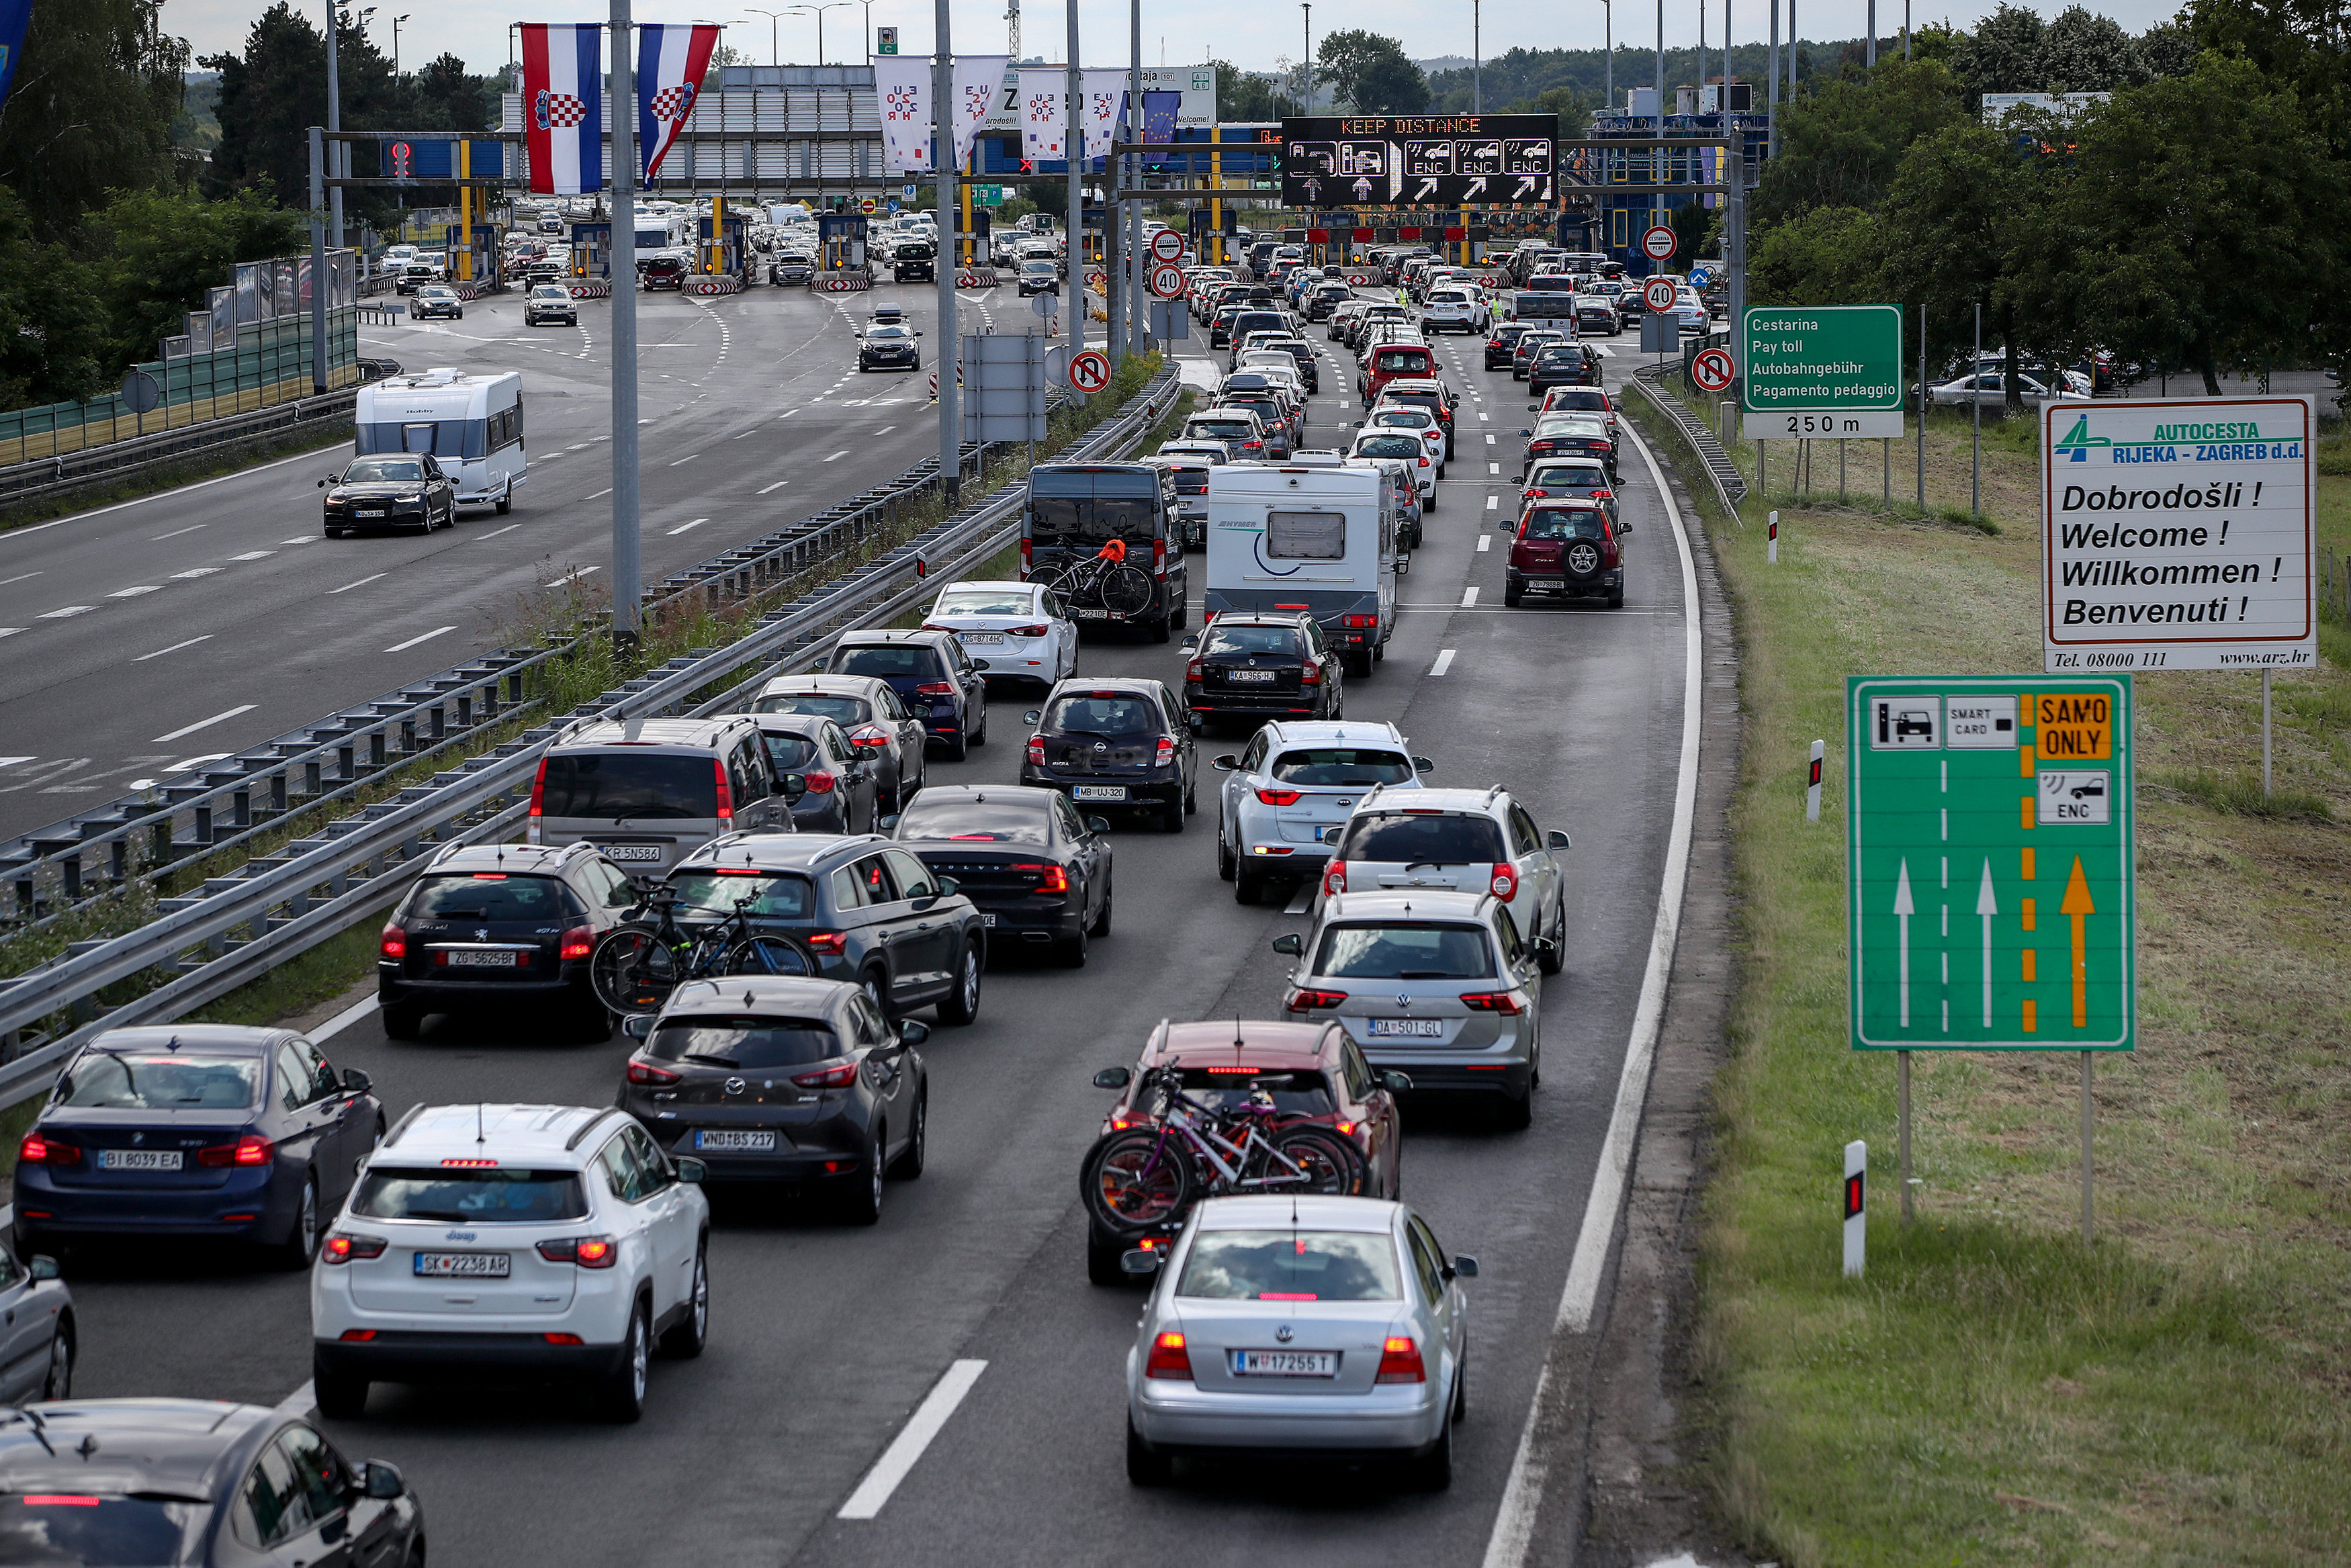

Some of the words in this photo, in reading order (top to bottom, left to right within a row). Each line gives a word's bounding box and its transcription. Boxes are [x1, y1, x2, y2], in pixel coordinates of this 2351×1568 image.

[1341, 119, 1387, 134] KEEP
[1395, 118, 1481, 134] DISTANCE
[1414, 163, 1444, 173] ENC
[1463, 163, 1493, 173] ENC
[1512, 161, 1542, 173] ENC
[1159, 273, 1177, 289] 40
[1650, 287, 1670, 303] 40
[1753, 318, 1818, 331] Cestarina
[1753, 340, 1777, 355] Pay
[1781, 340, 1803, 353] toll
[1752, 361, 1864, 377] Autobahngebühr
[1753, 384, 1830, 400] Pagamento
[1834, 383, 1896, 399] pedaggio
[1787, 416, 1833, 432] 250
[1843, 418, 1860, 432] m
[2154, 422, 2260, 441] AUTOCESTA
[2113, 446, 2177, 464] RIJEKA
[2196, 444, 2266, 461] ZAGREB
[2272, 443, 2304, 460] d.d.
[2061, 481, 2244, 511] Dobrodošli
[2061, 522, 2208, 550] Welcome
[2061, 559, 2260, 587] Willkommen
[2063, 596, 2229, 625] Benvenuti
[965, 635, 973, 643] ZG
[2054, 653, 2080, 667] Tel.
[2086, 652, 2134, 667] 08000
[2141, 652, 2166, 666] 111
[2219, 649, 2311, 665] www.arz.hr
[1233, 672, 1243, 680] KA
[1950, 709, 1990, 720] SMART
[2041, 698, 2106, 724] SAMO
[1955, 725, 1988, 735] CARD
[2046, 730, 2101, 754] ONLY
[1080, 788, 1092, 796] MB
[1098, 788, 1123, 797] UJ-320
[2057, 804, 2090, 818] ENC
[605, 848, 621, 858] KR
[625, 848, 657, 859] 5N586
[456, 952, 468, 963] ZG
[1377, 1023, 1390, 1033] DA
[752, 1134, 772, 1146] 217
[106, 1152, 122, 1165] BI
[126, 1153, 157, 1166] 8039
[161, 1154, 181, 1166] EA
[425, 1256, 442, 1271] SK
[452, 1257, 486, 1271] 2238
[490, 1258, 507, 1271] AR
[1249, 1354, 1259, 1369] W
